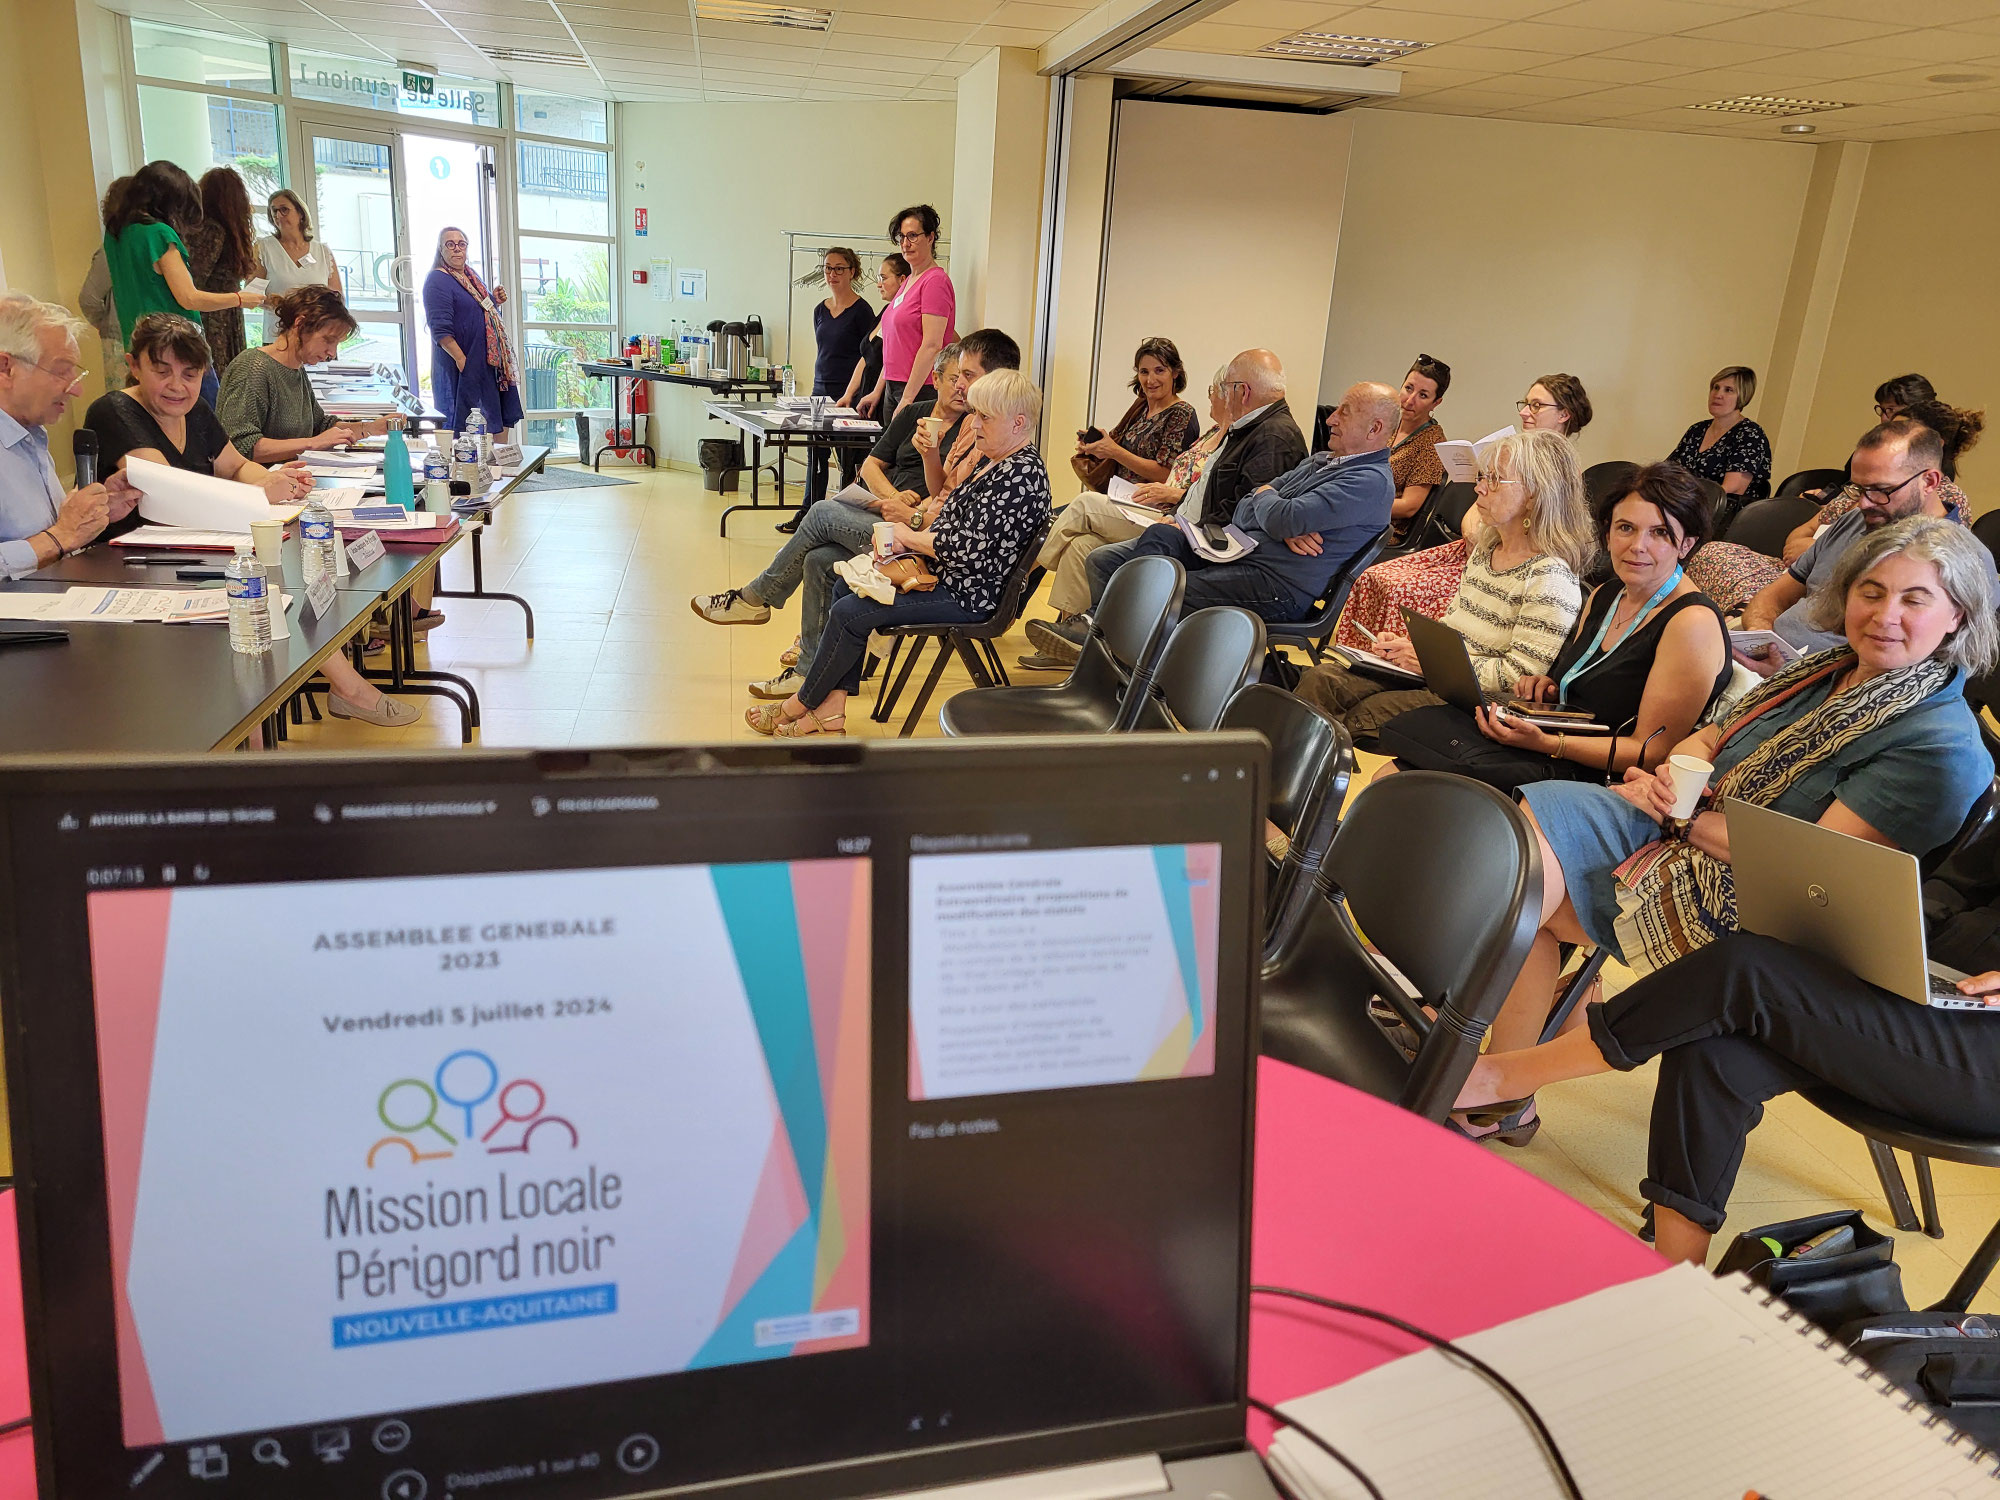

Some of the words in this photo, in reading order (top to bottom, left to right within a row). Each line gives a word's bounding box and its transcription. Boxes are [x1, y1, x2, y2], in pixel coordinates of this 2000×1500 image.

[313, 926, 473, 952] ASSEMBLEE
[480, 917, 617, 943] GENERALE
[440, 951, 501, 972] 2023
[322, 1008, 444, 1034] Vendredi
[451, 1006, 465, 1024] 5
[471, 1001, 545, 1028] juillet
[554, 998, 613, 1018] 2024
[324, 1180, 489, 1240] Mission
[498, 1165, 623, 1222] Locale
[335, 1232, 520, 1301] Périgord
[533, 1224, 616, 1278] noir
[341, 1290, 609, 1342] NOUVELLE-AQUITAINE
